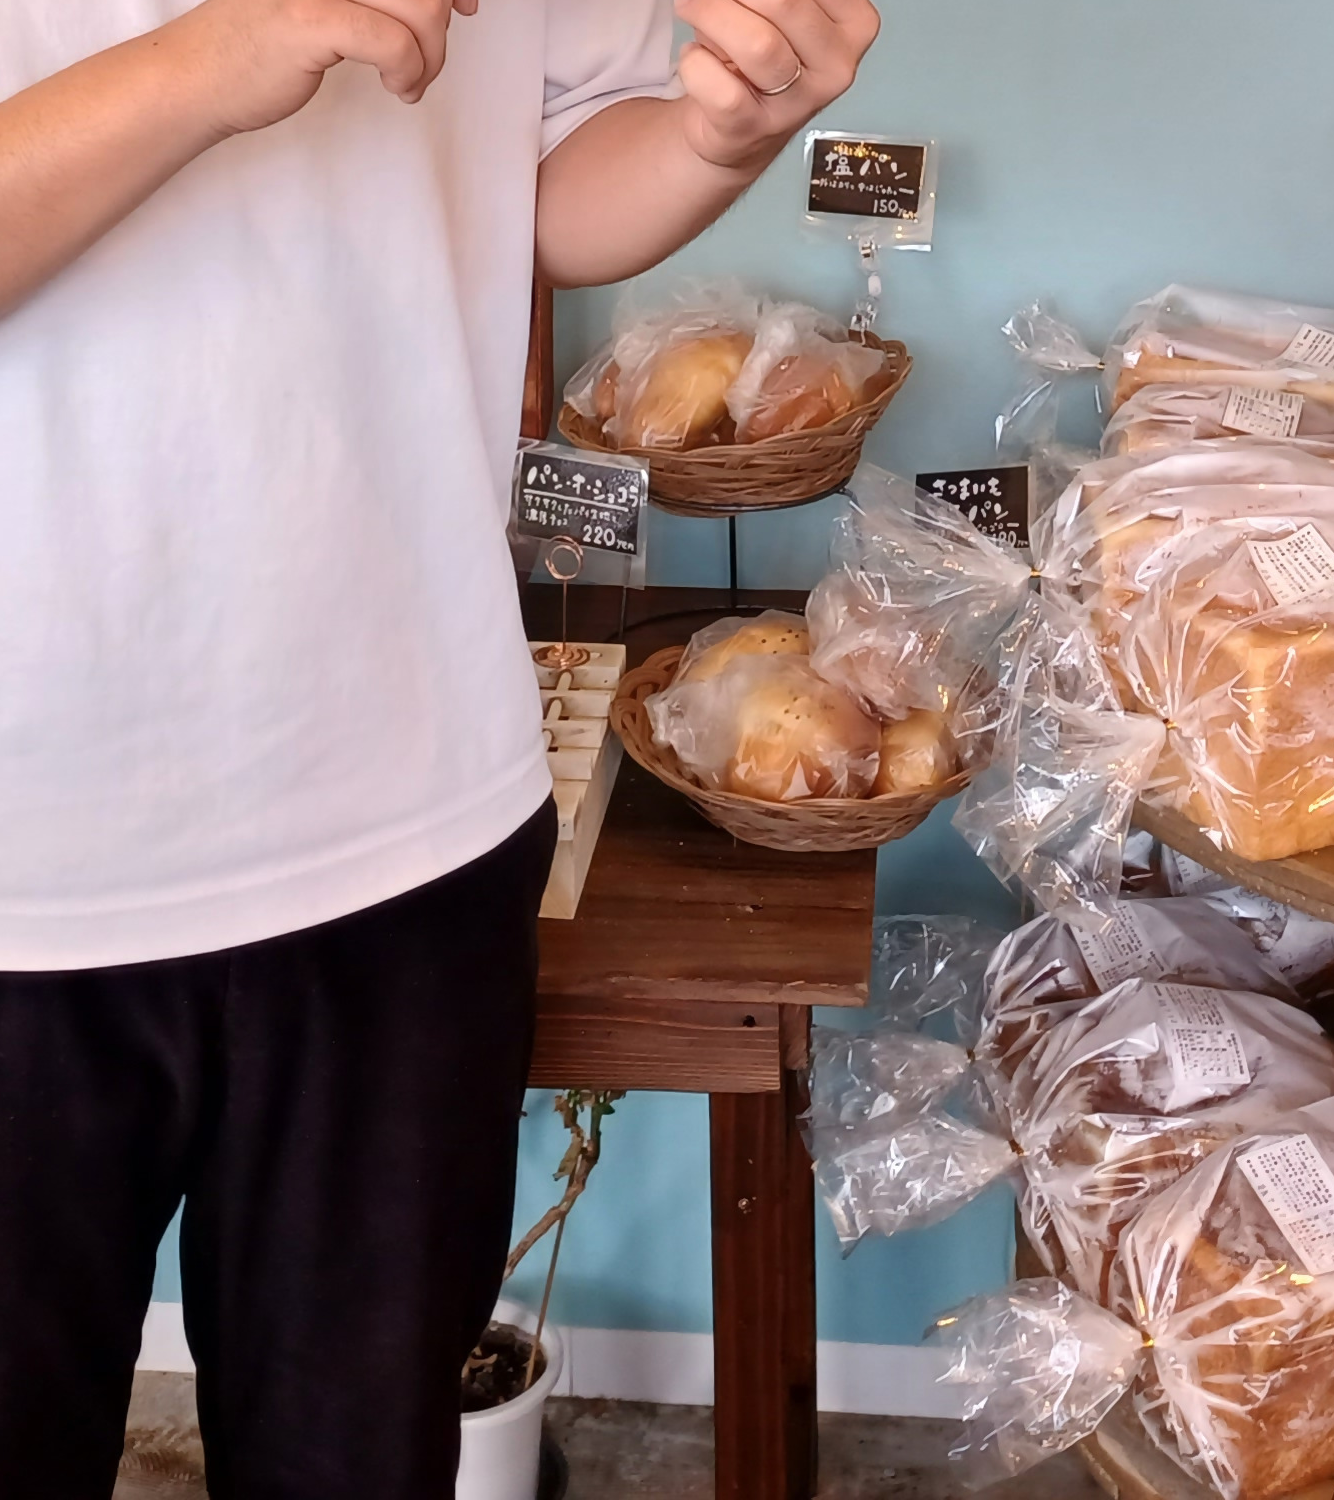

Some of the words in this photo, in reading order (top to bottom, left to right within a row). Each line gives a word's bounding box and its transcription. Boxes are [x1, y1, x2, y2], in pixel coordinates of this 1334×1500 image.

[824, 150, 908, 180] 塩パン
[526, 464, 639, 508] パン・オ・ショコラ
[932, 476, 1002, 501] さつまいも
